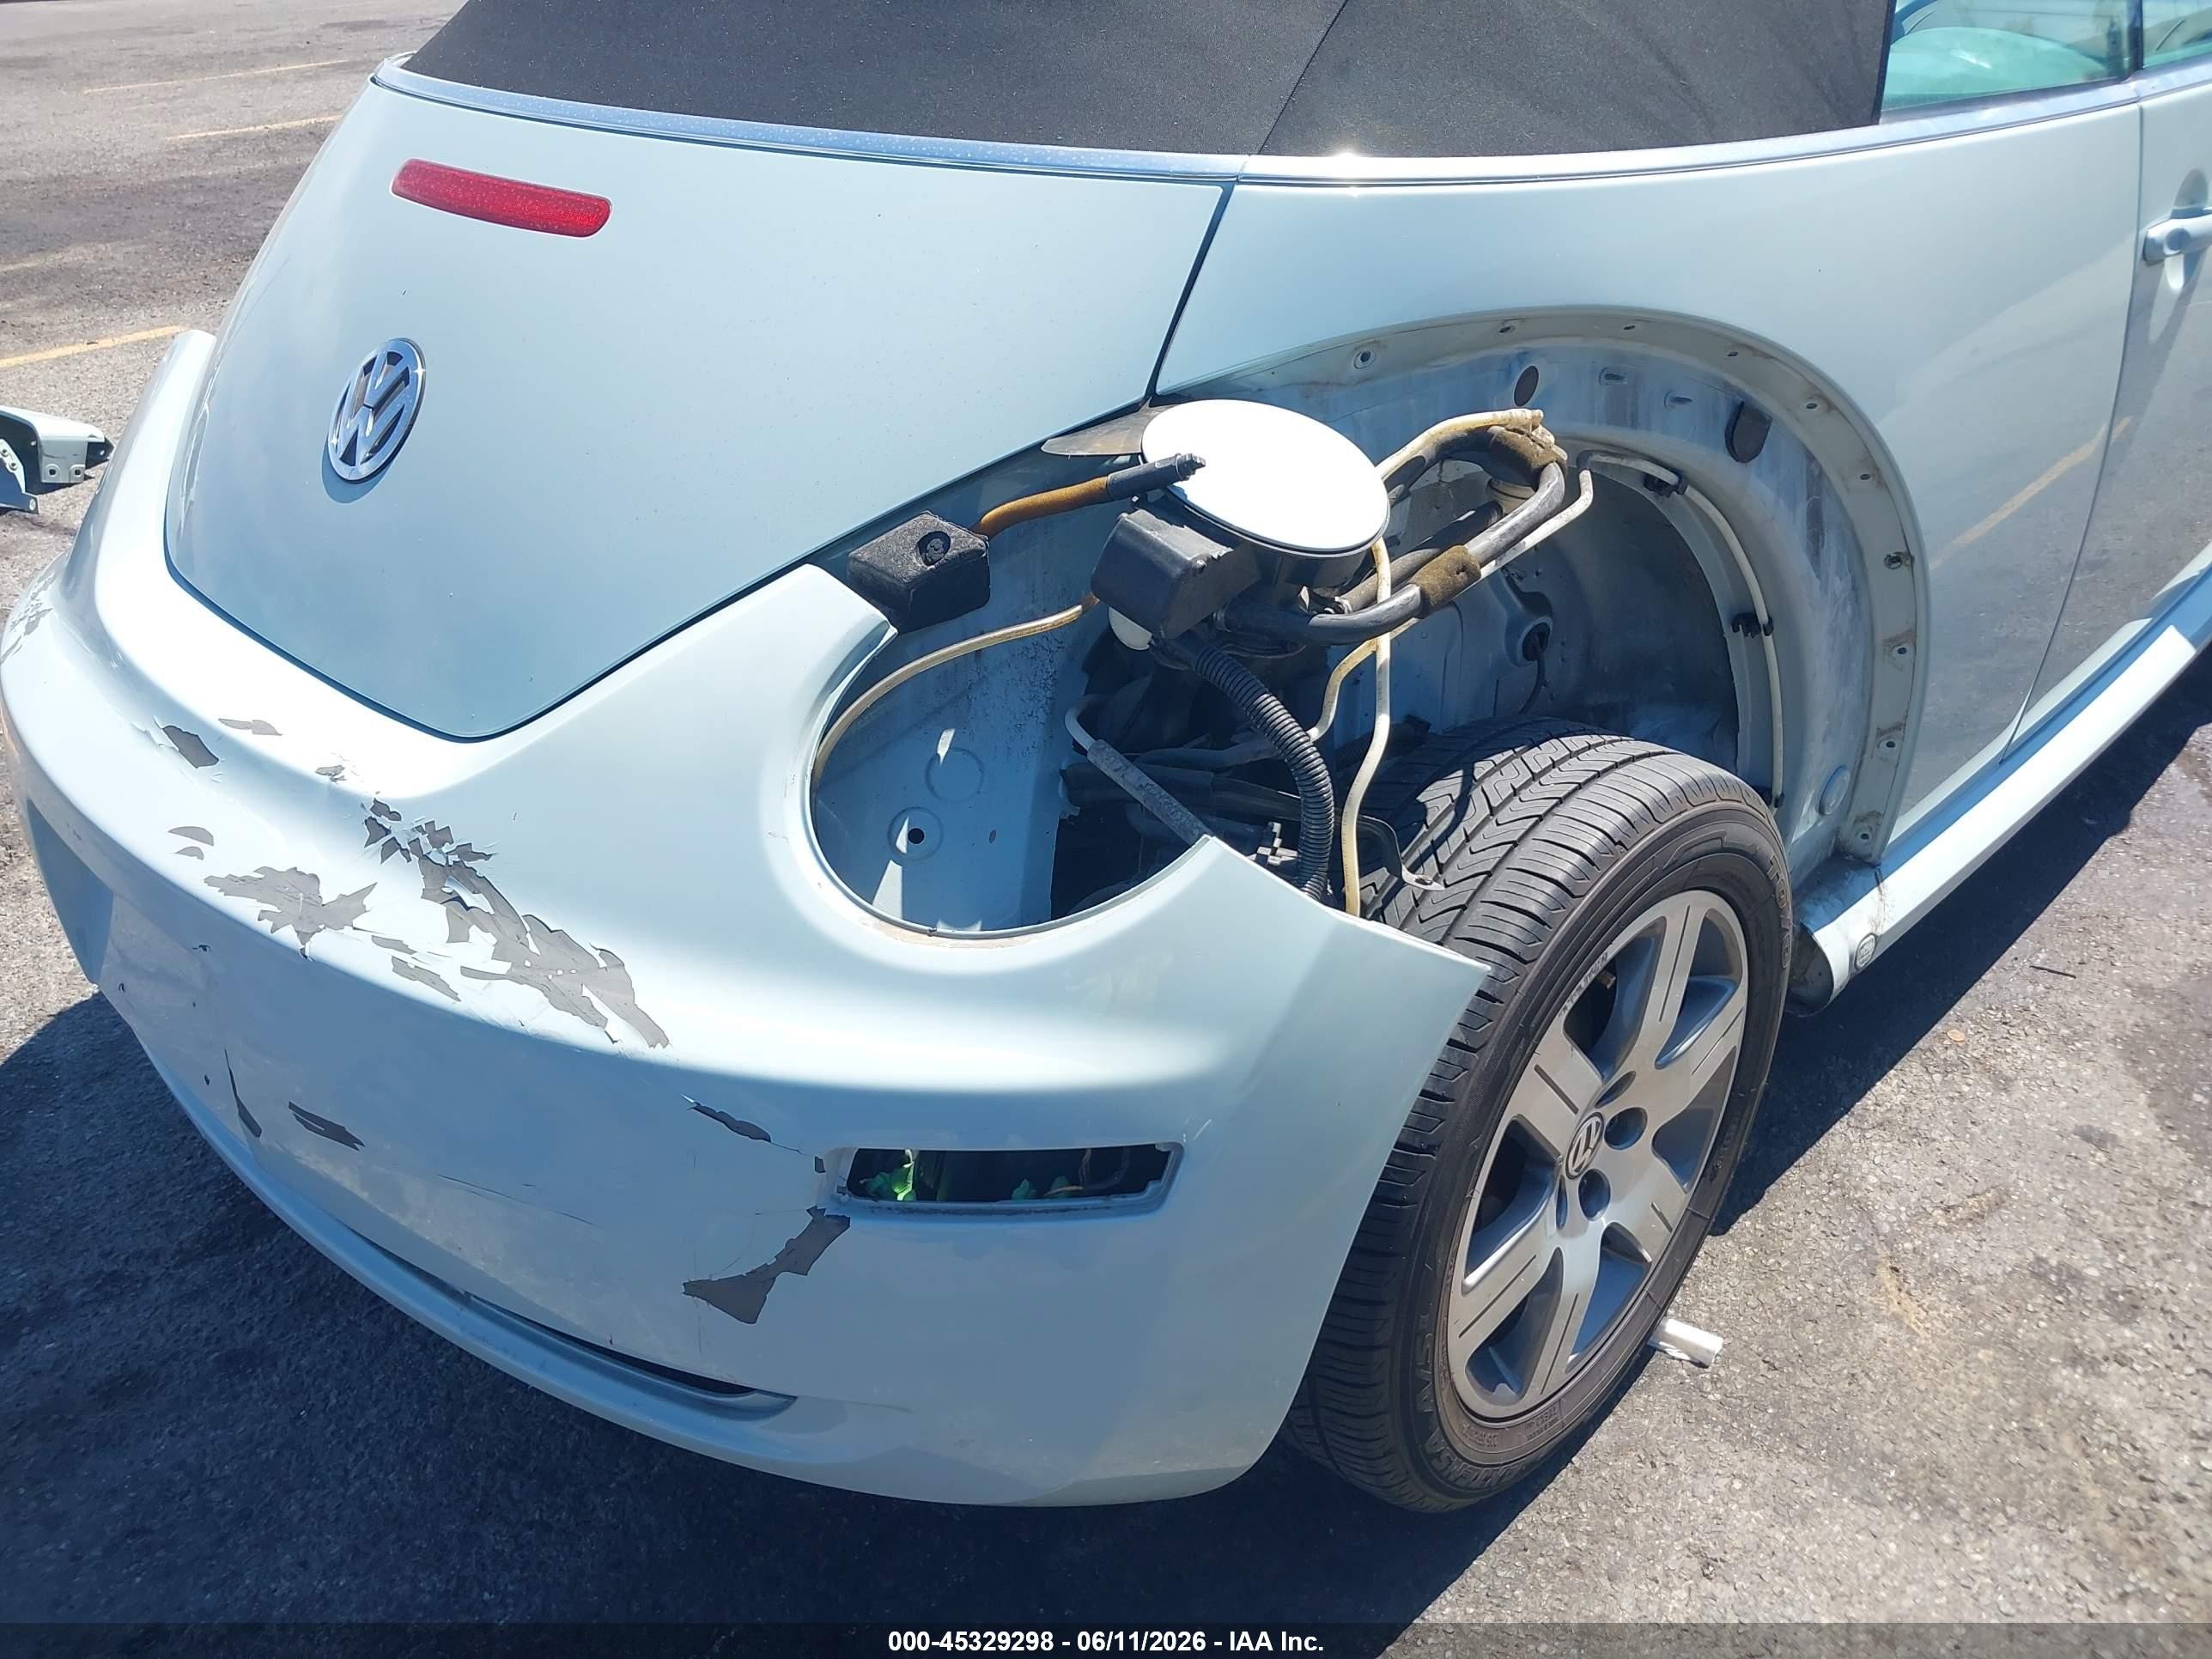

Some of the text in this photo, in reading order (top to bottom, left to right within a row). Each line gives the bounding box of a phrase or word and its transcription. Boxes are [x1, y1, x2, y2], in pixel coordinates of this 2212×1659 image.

[329, 340, 422, 481] VW
[1767, 854, 1792, 969] TOYO
[1566, 1114, 1603, 1178] VW
